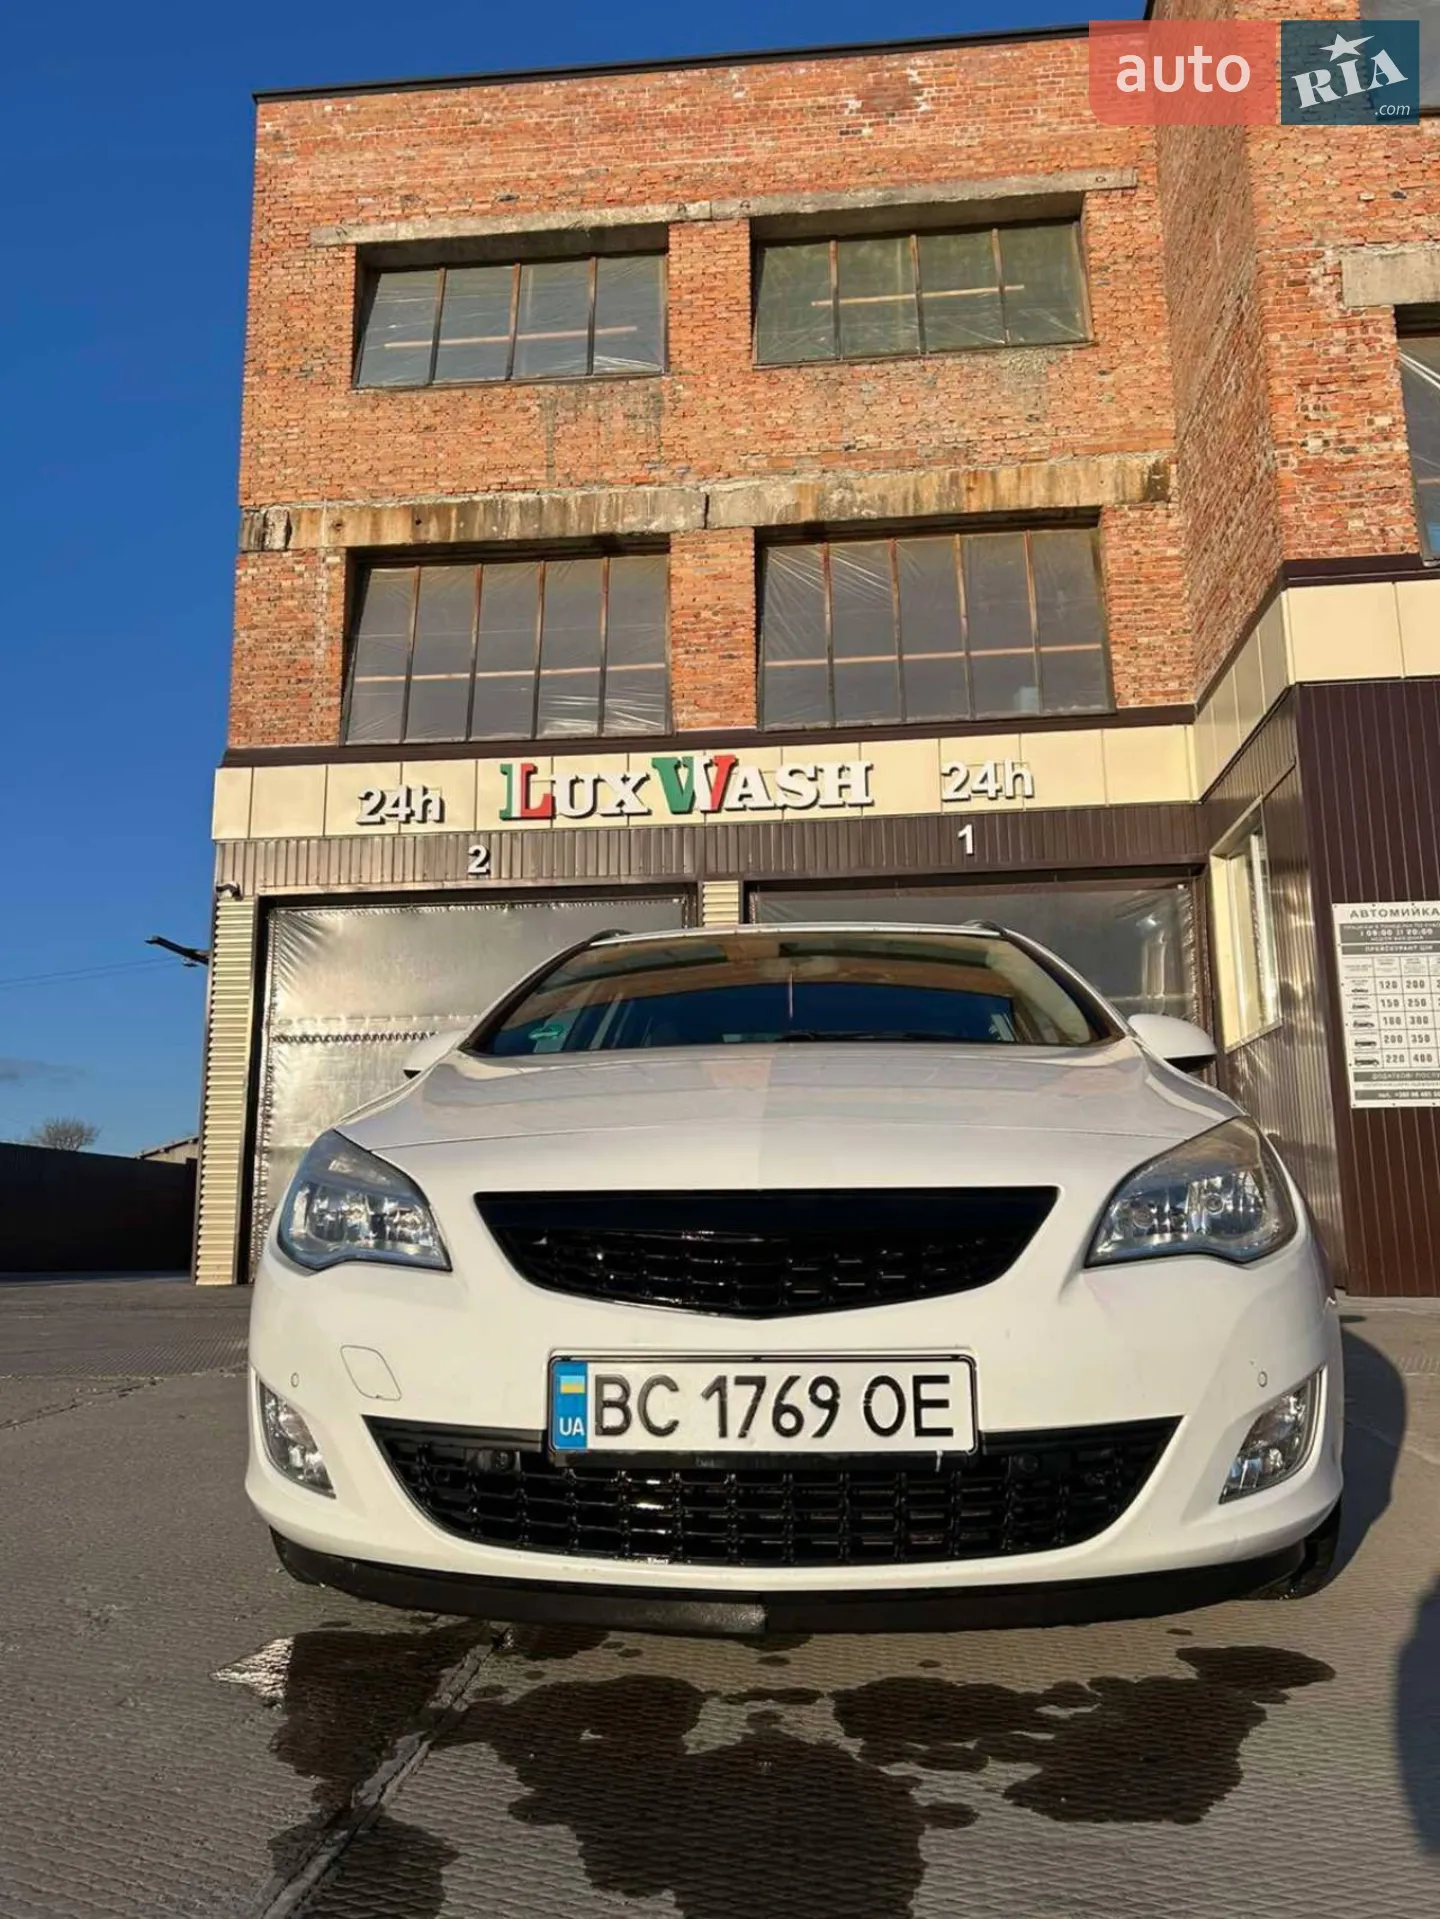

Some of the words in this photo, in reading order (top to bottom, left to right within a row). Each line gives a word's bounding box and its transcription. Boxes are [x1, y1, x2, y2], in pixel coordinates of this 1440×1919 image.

[941, 759, 1035, 802] 24h
[356, 785, 445, 825] 24h
[957, 824, 975, 855] 1
[467, 844, 490, 875] 2
[1350, 905, 1440, 919] АВТОМИЙКА
[1406, 980, 1425, 989] 200
[1381, 999, 1399, 1008] 150
[1408, 998, 1427, 1007] 250
[1384, 1034, 1403, 1044] 200
[1386, 1054, 1405, 1063] 220
[594, 1374, 680, 1437] BC
[700, 1374, 841, 1438] 1769
[863, 1374, 954, 1437] OE
[559, 1417, 585, 1436] UA
